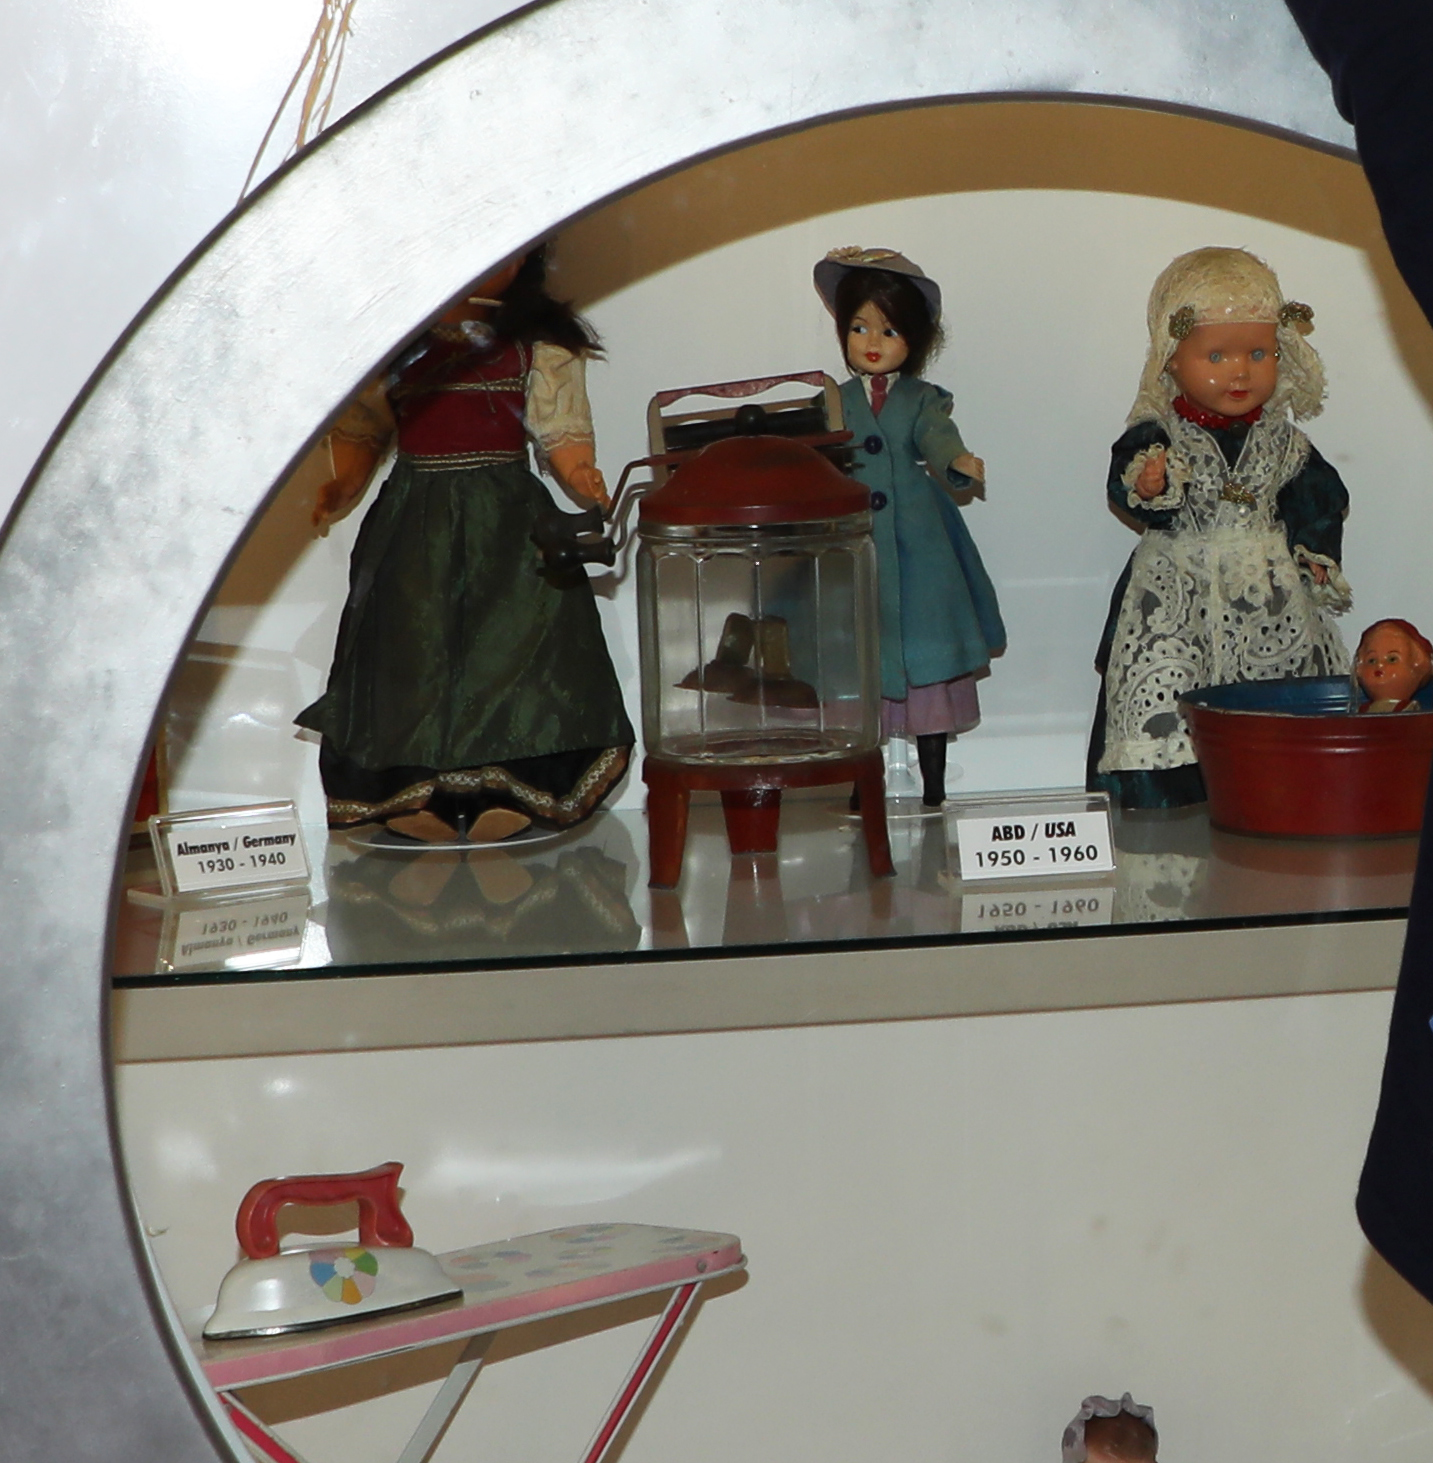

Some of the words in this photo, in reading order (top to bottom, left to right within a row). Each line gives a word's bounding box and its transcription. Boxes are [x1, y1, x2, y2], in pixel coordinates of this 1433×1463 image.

[991, 825, 1025, 842] ABD
[1030, 823, 1039, 841] /
[1044, 821, 1076, 838] USA
[176, 841, 230, 856] Almanya
[242, 833, 296, 849] Germany
[975, 849, 1025, 867] 1950
[1048, 844, 1098, 863] 1960
[198, 858, 235, 874] 1930
[250, 851, 286, 868] 1940
